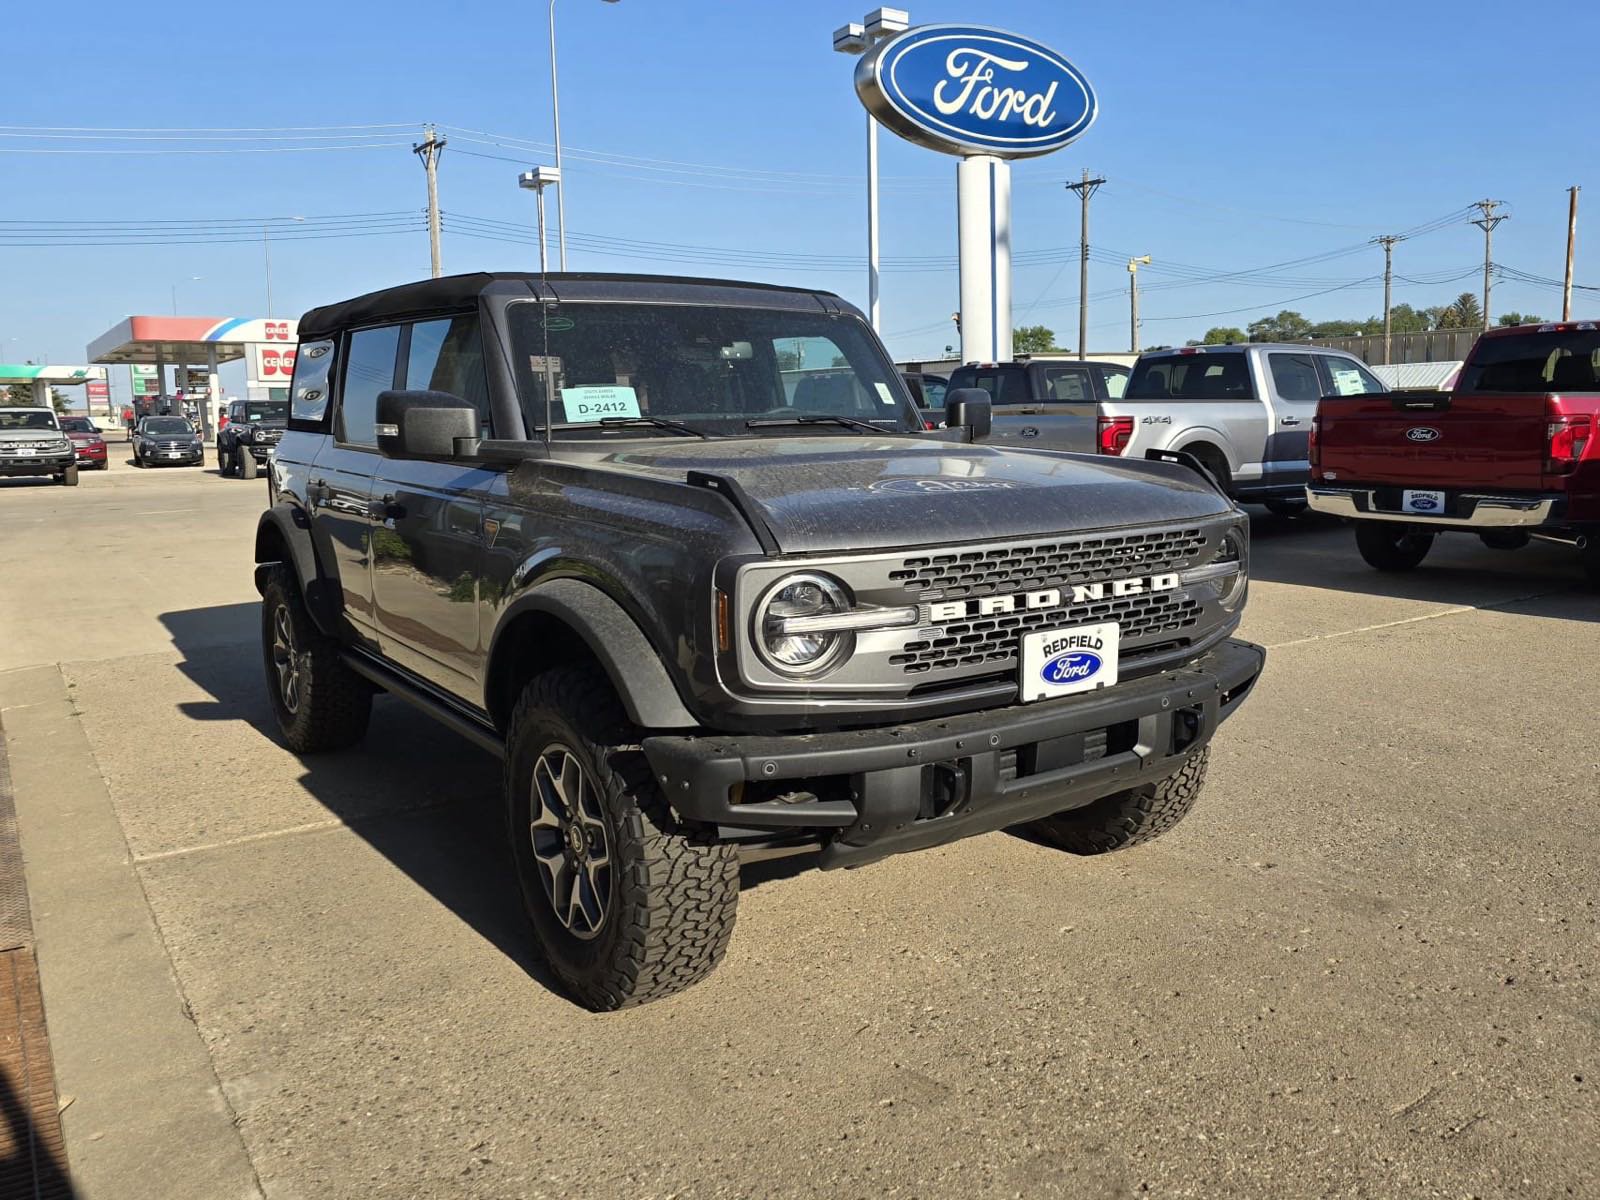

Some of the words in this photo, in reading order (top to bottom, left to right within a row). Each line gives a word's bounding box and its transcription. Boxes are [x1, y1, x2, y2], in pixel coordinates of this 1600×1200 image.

[934, 47, 1059, 128] Ford
[578, 401, 627, 414] D-2412
[1411, 429, 1433, 439] Ford
[929, 572, 1179, 622] BRONCO
[1043, 636, 1103, 658] REDFIELD
[1053, 656, 1091, 680] Ford
